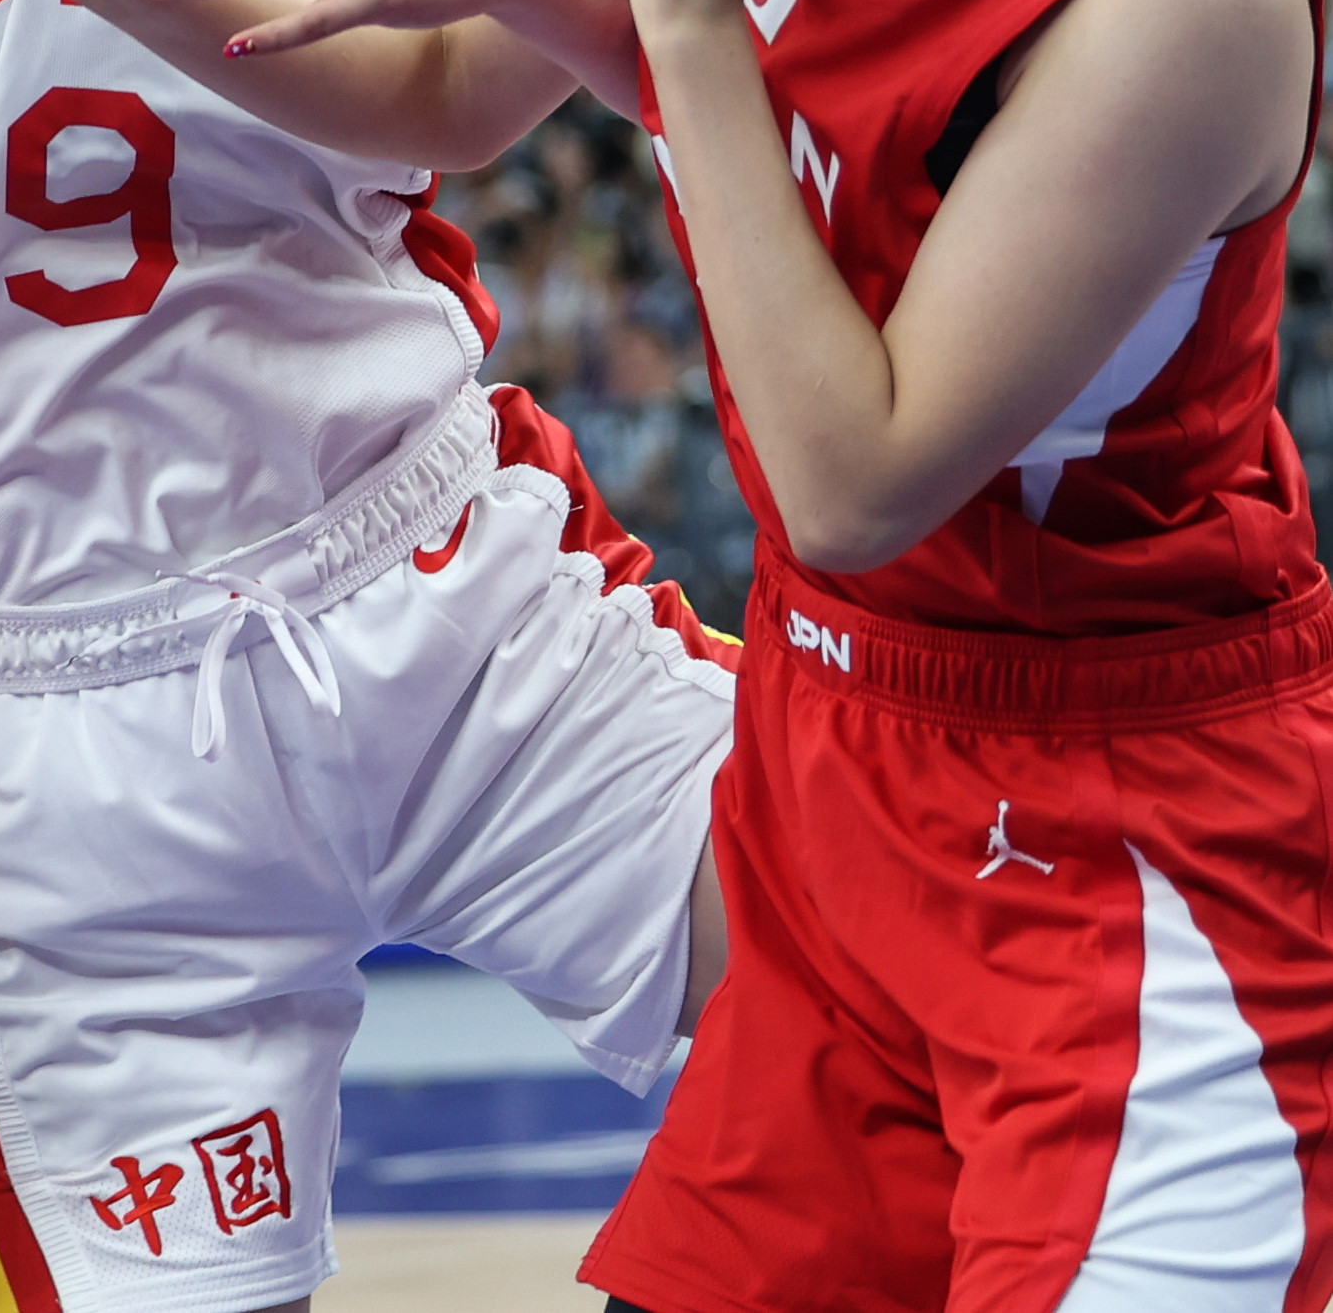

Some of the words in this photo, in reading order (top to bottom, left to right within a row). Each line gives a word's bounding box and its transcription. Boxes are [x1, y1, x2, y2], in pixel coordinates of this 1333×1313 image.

[4, 86, 179, 328] 9
[786, 608, 852, 673] JPN
[88, 1107, 291, 1257] 中国
